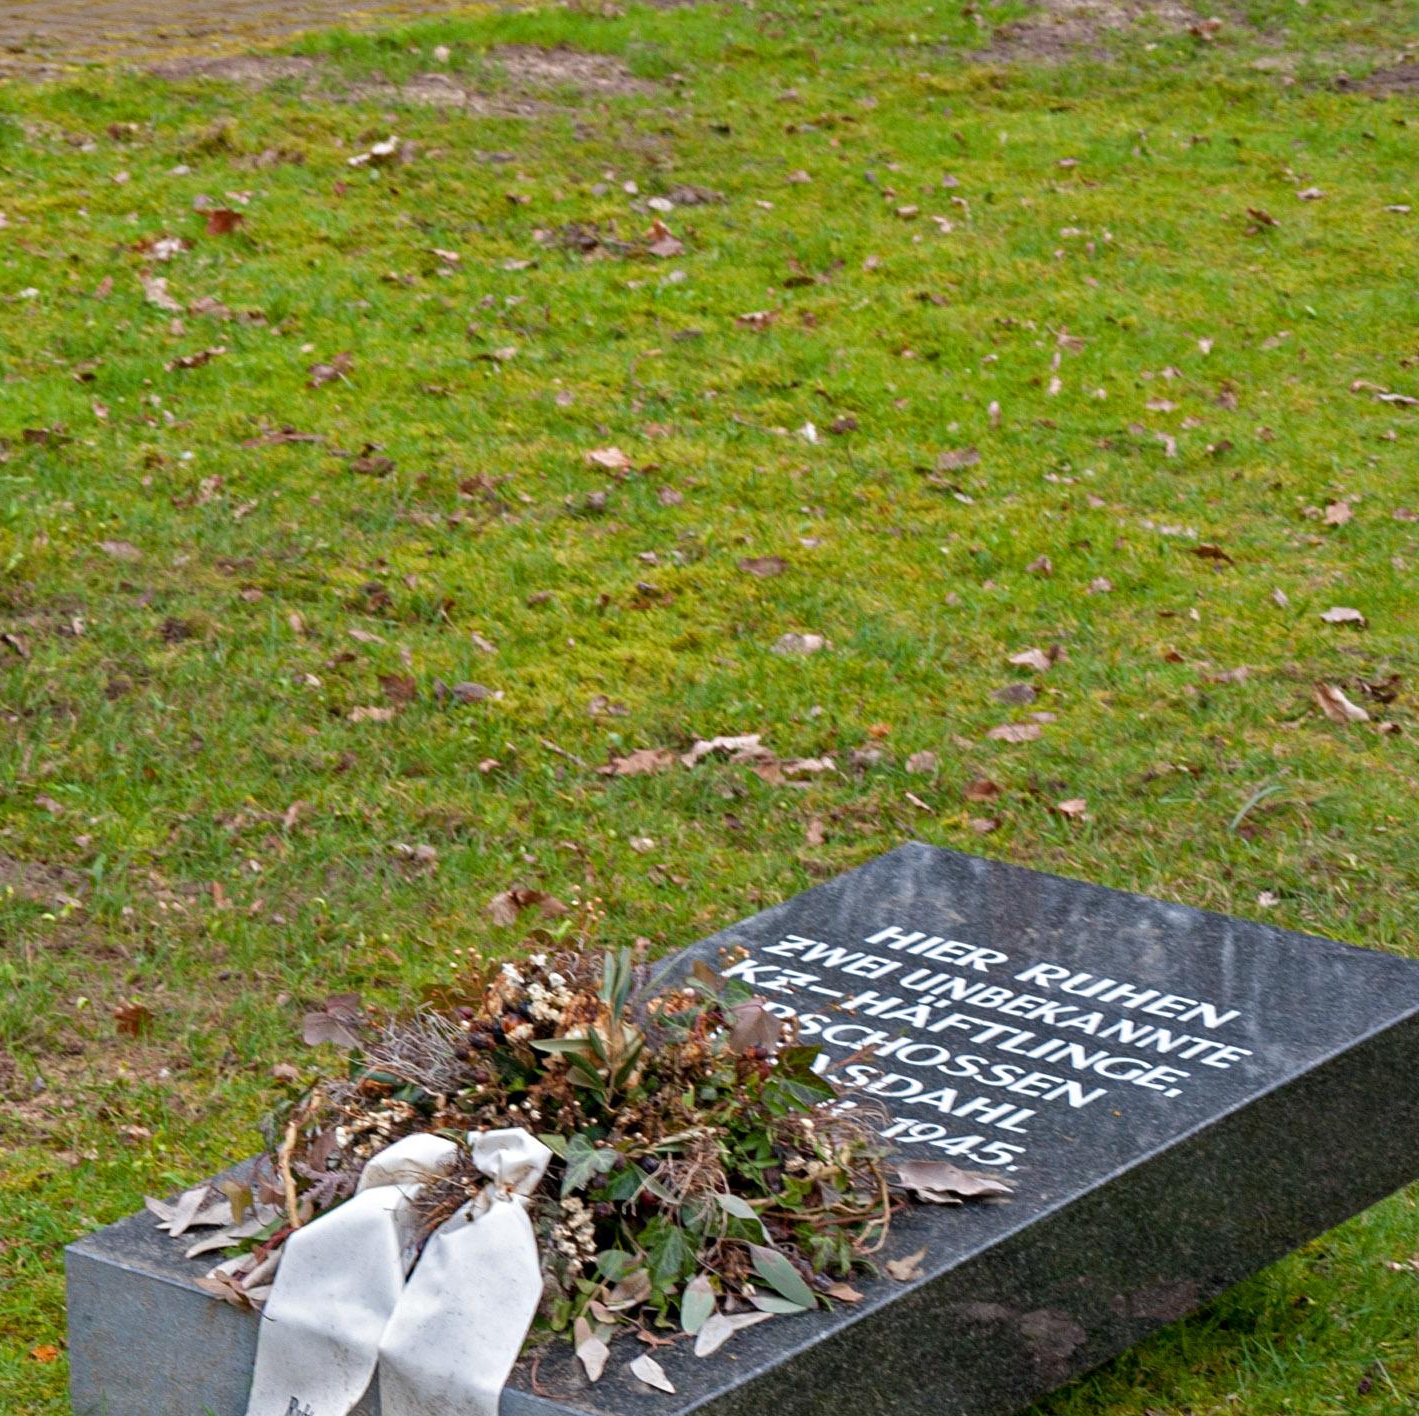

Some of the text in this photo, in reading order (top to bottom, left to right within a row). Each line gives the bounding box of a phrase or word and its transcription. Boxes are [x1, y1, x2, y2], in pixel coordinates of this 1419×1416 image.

[761, 934, 1253, 1069] ZWEI UNBEKANNTE
[864, 926, 1242, 1029] HIER RUHEN
[879, 1116, 1027, 1172] 1945.
